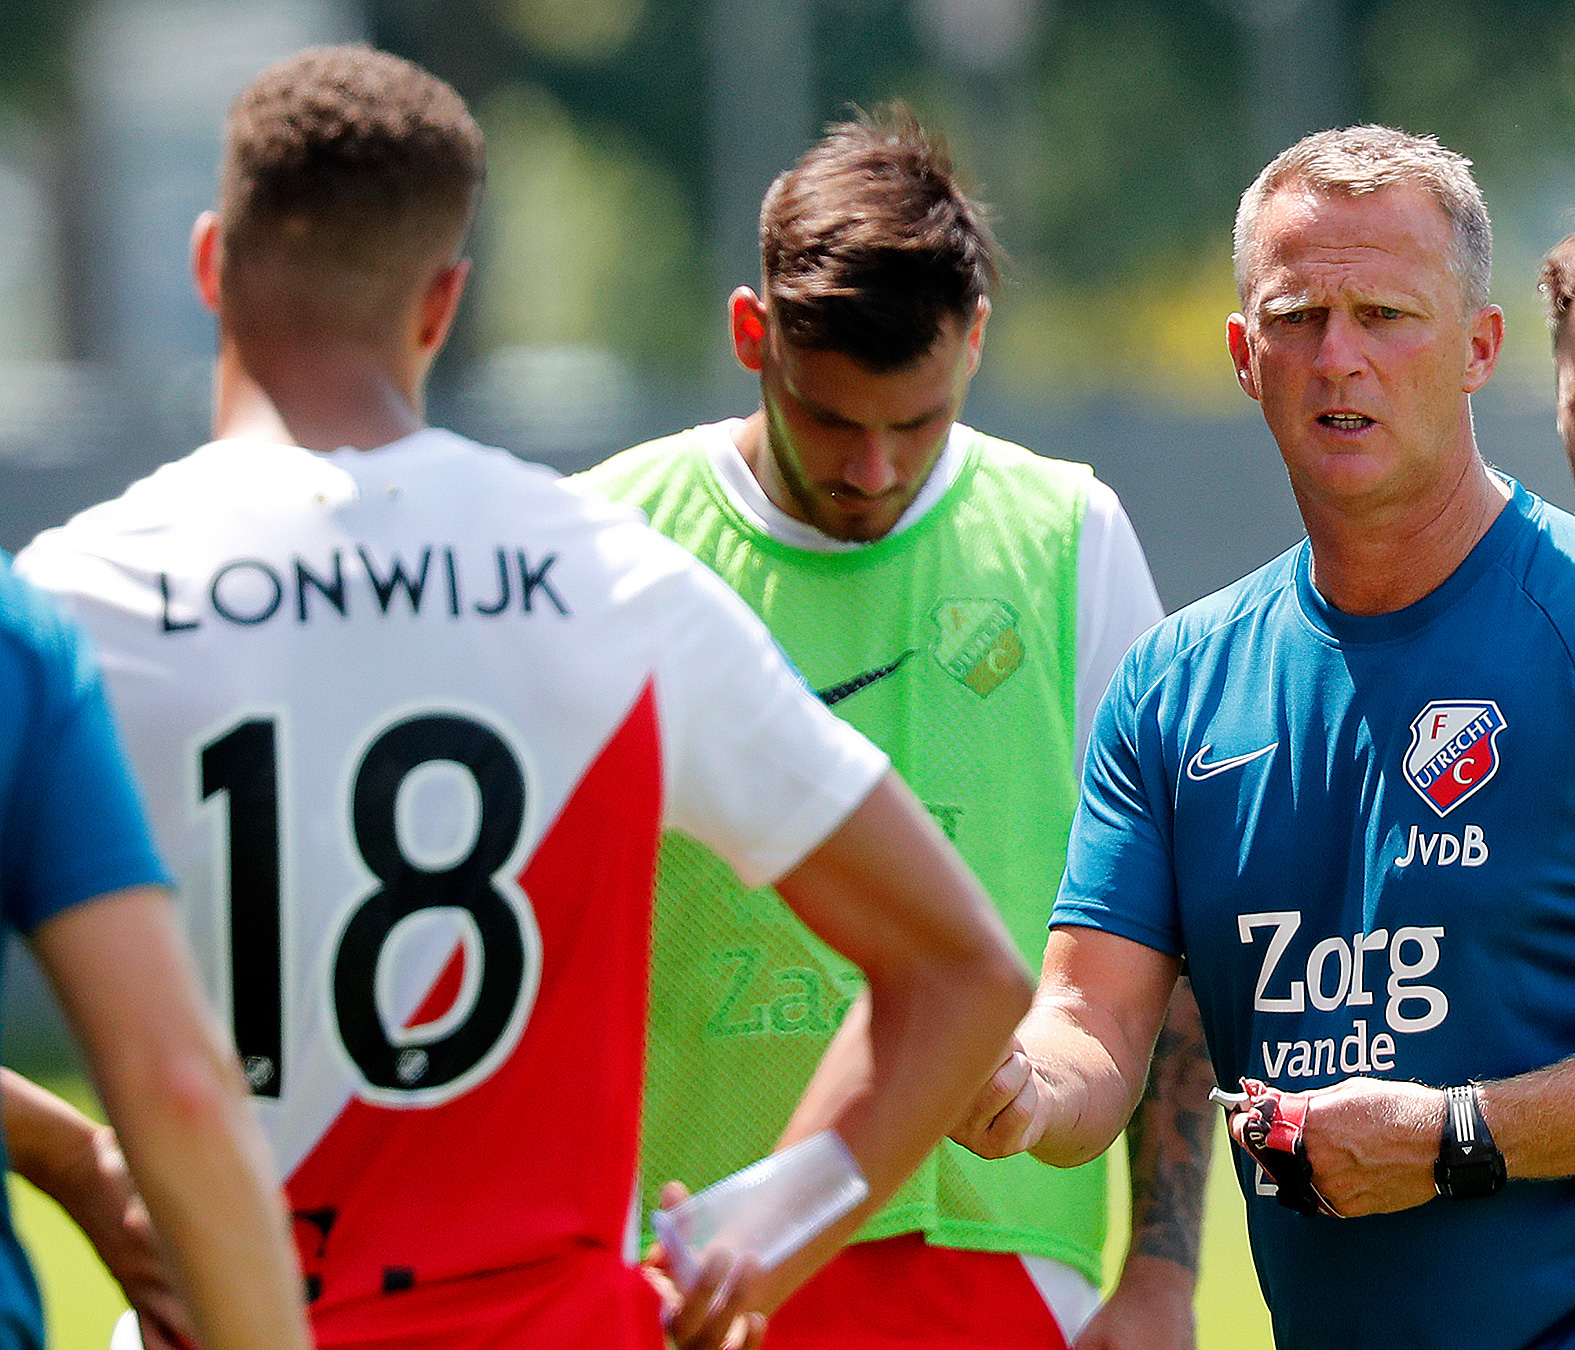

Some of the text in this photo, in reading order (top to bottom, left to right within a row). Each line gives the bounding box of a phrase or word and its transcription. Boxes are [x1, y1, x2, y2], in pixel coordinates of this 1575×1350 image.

[158, 543, 572, 634] LONWIJK
[1415, 710, 1494, 790] UTRECHT
[1431, 713, 1448, 740] F
[1452, 757, 1475, 785] C
[196, 706, 536, 1104] 18
[1237, 910, 1449, 1034] Zorg
